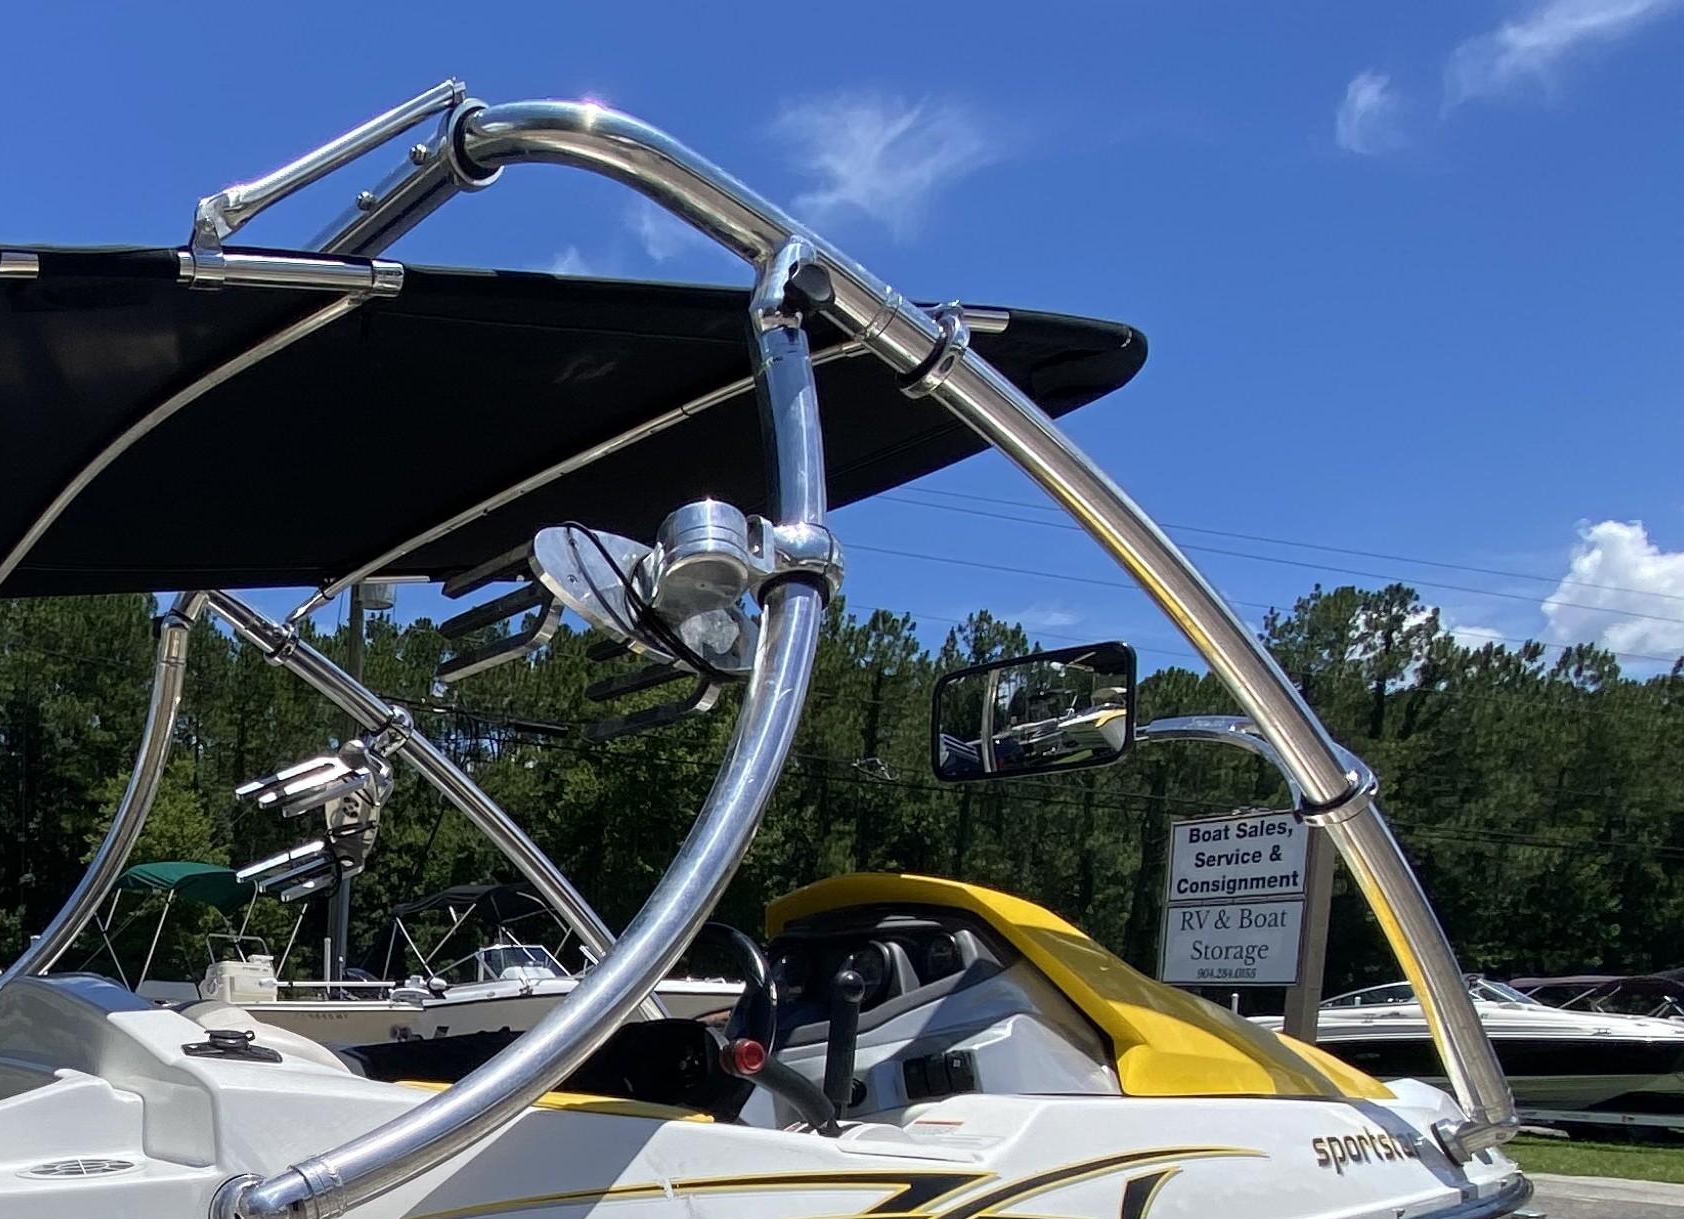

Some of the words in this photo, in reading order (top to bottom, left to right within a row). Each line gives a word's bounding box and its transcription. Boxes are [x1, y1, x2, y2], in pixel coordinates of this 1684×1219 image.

[1188, 827, 1230, 843] Boat
[1235, 820, 1293, 839] Sales,
[1194, 848, 1262, 868] Service
[1269, 844, 1283, 861] &
[1176, 870, 1299, 894] Consignment
[1180, 909, 1211, 931] RV
[1214, 909, 1231, 930] &
[1238, 908, 1288, 929] Boat
[1190, 940, 1269, 966] Storage
